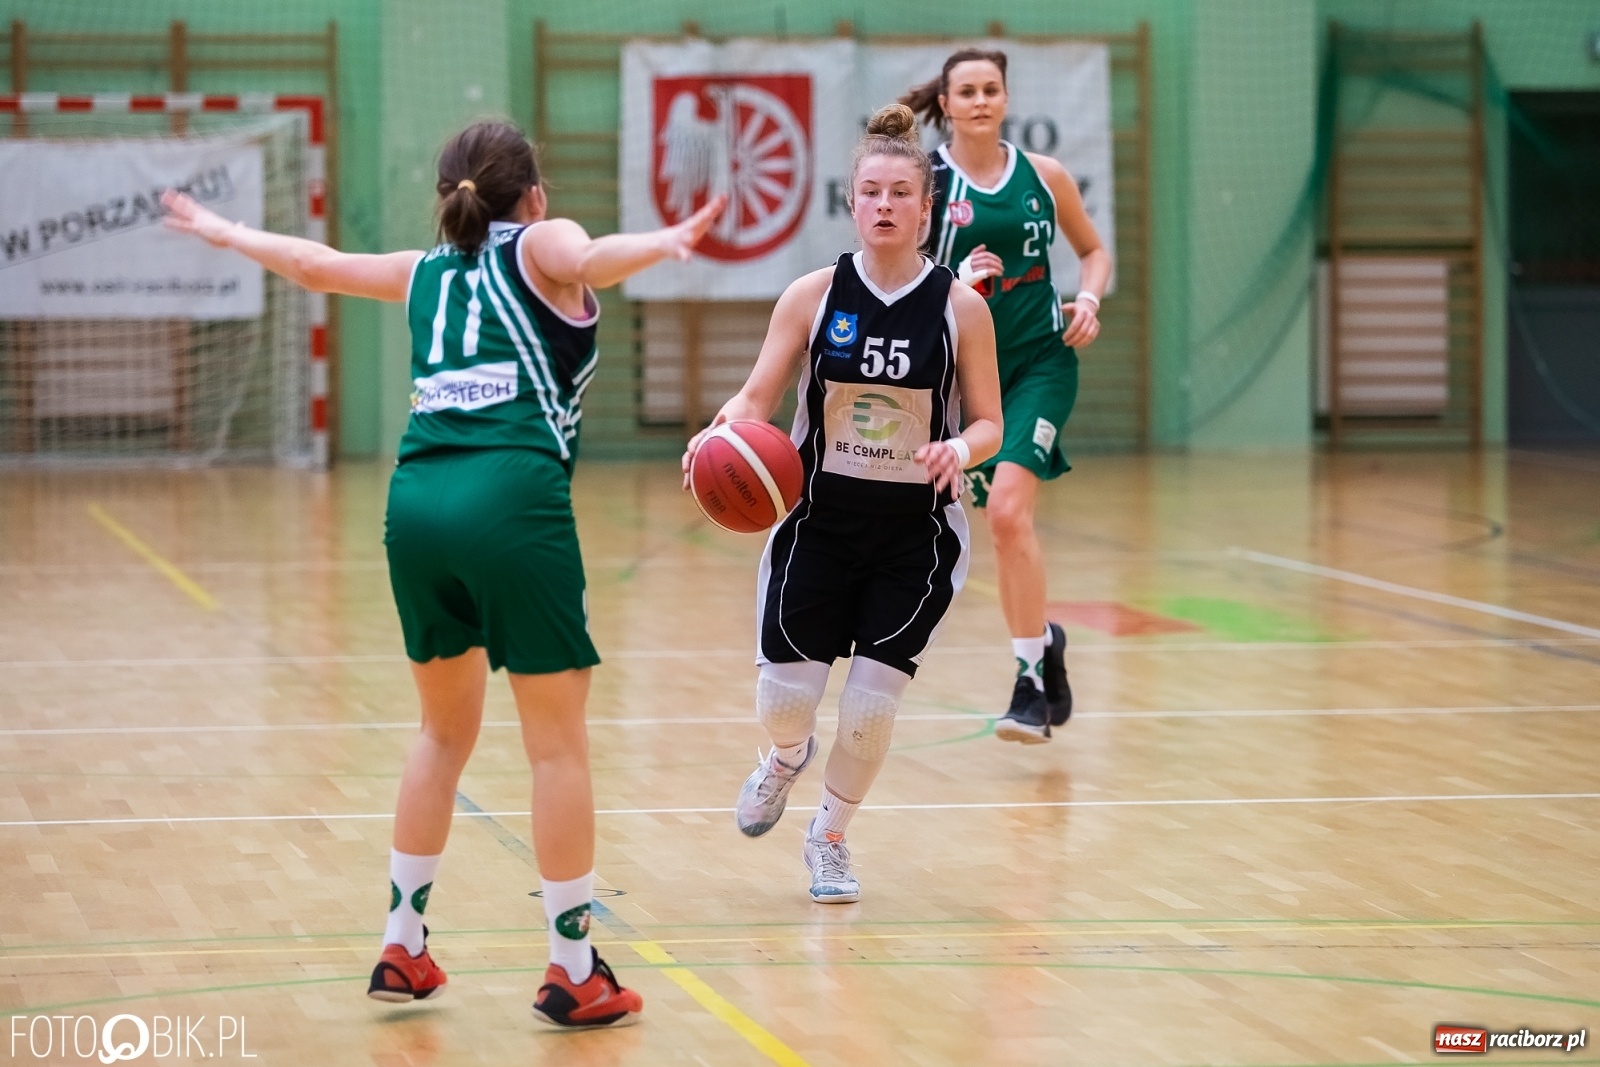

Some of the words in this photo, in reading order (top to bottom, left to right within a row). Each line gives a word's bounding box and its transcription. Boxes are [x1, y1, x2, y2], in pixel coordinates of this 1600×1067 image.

[427, 269, 482, 364] 11
[860, 336, 911, 380] 55
[836, 441, 850, 453] BE
[723, 463, 757, 507] molten
